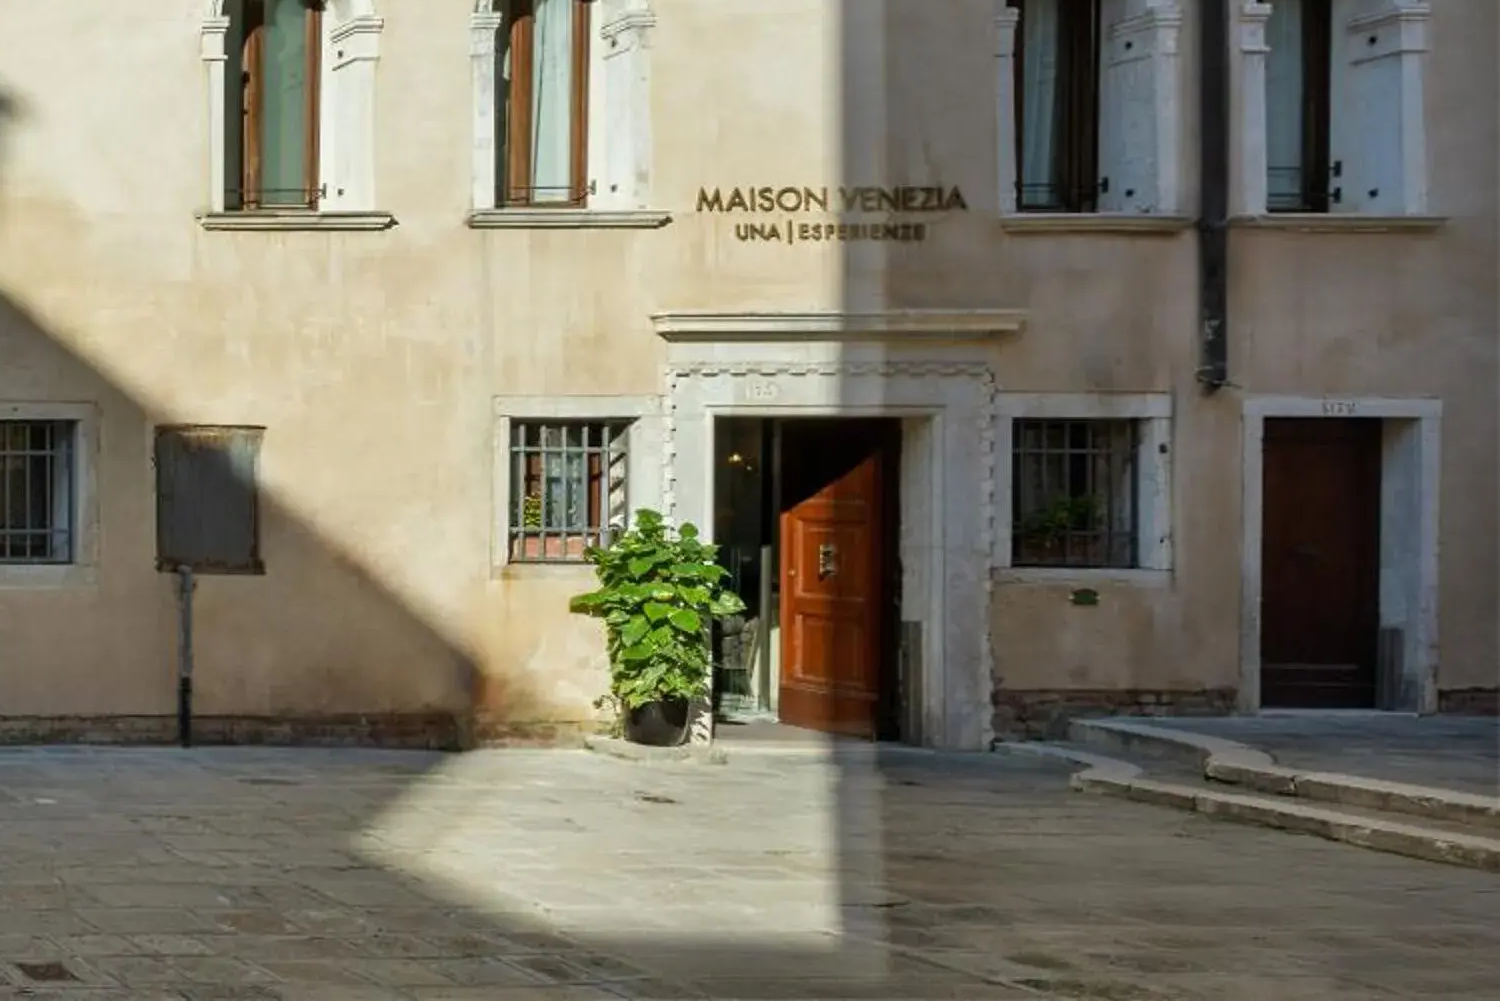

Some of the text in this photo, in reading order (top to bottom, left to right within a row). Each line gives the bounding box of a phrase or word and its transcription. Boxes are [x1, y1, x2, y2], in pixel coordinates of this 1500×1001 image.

[695, 185, 968, 212] MAISON VENEZIA
[734, 222, 926, 241] UNA ESPERIENZE
